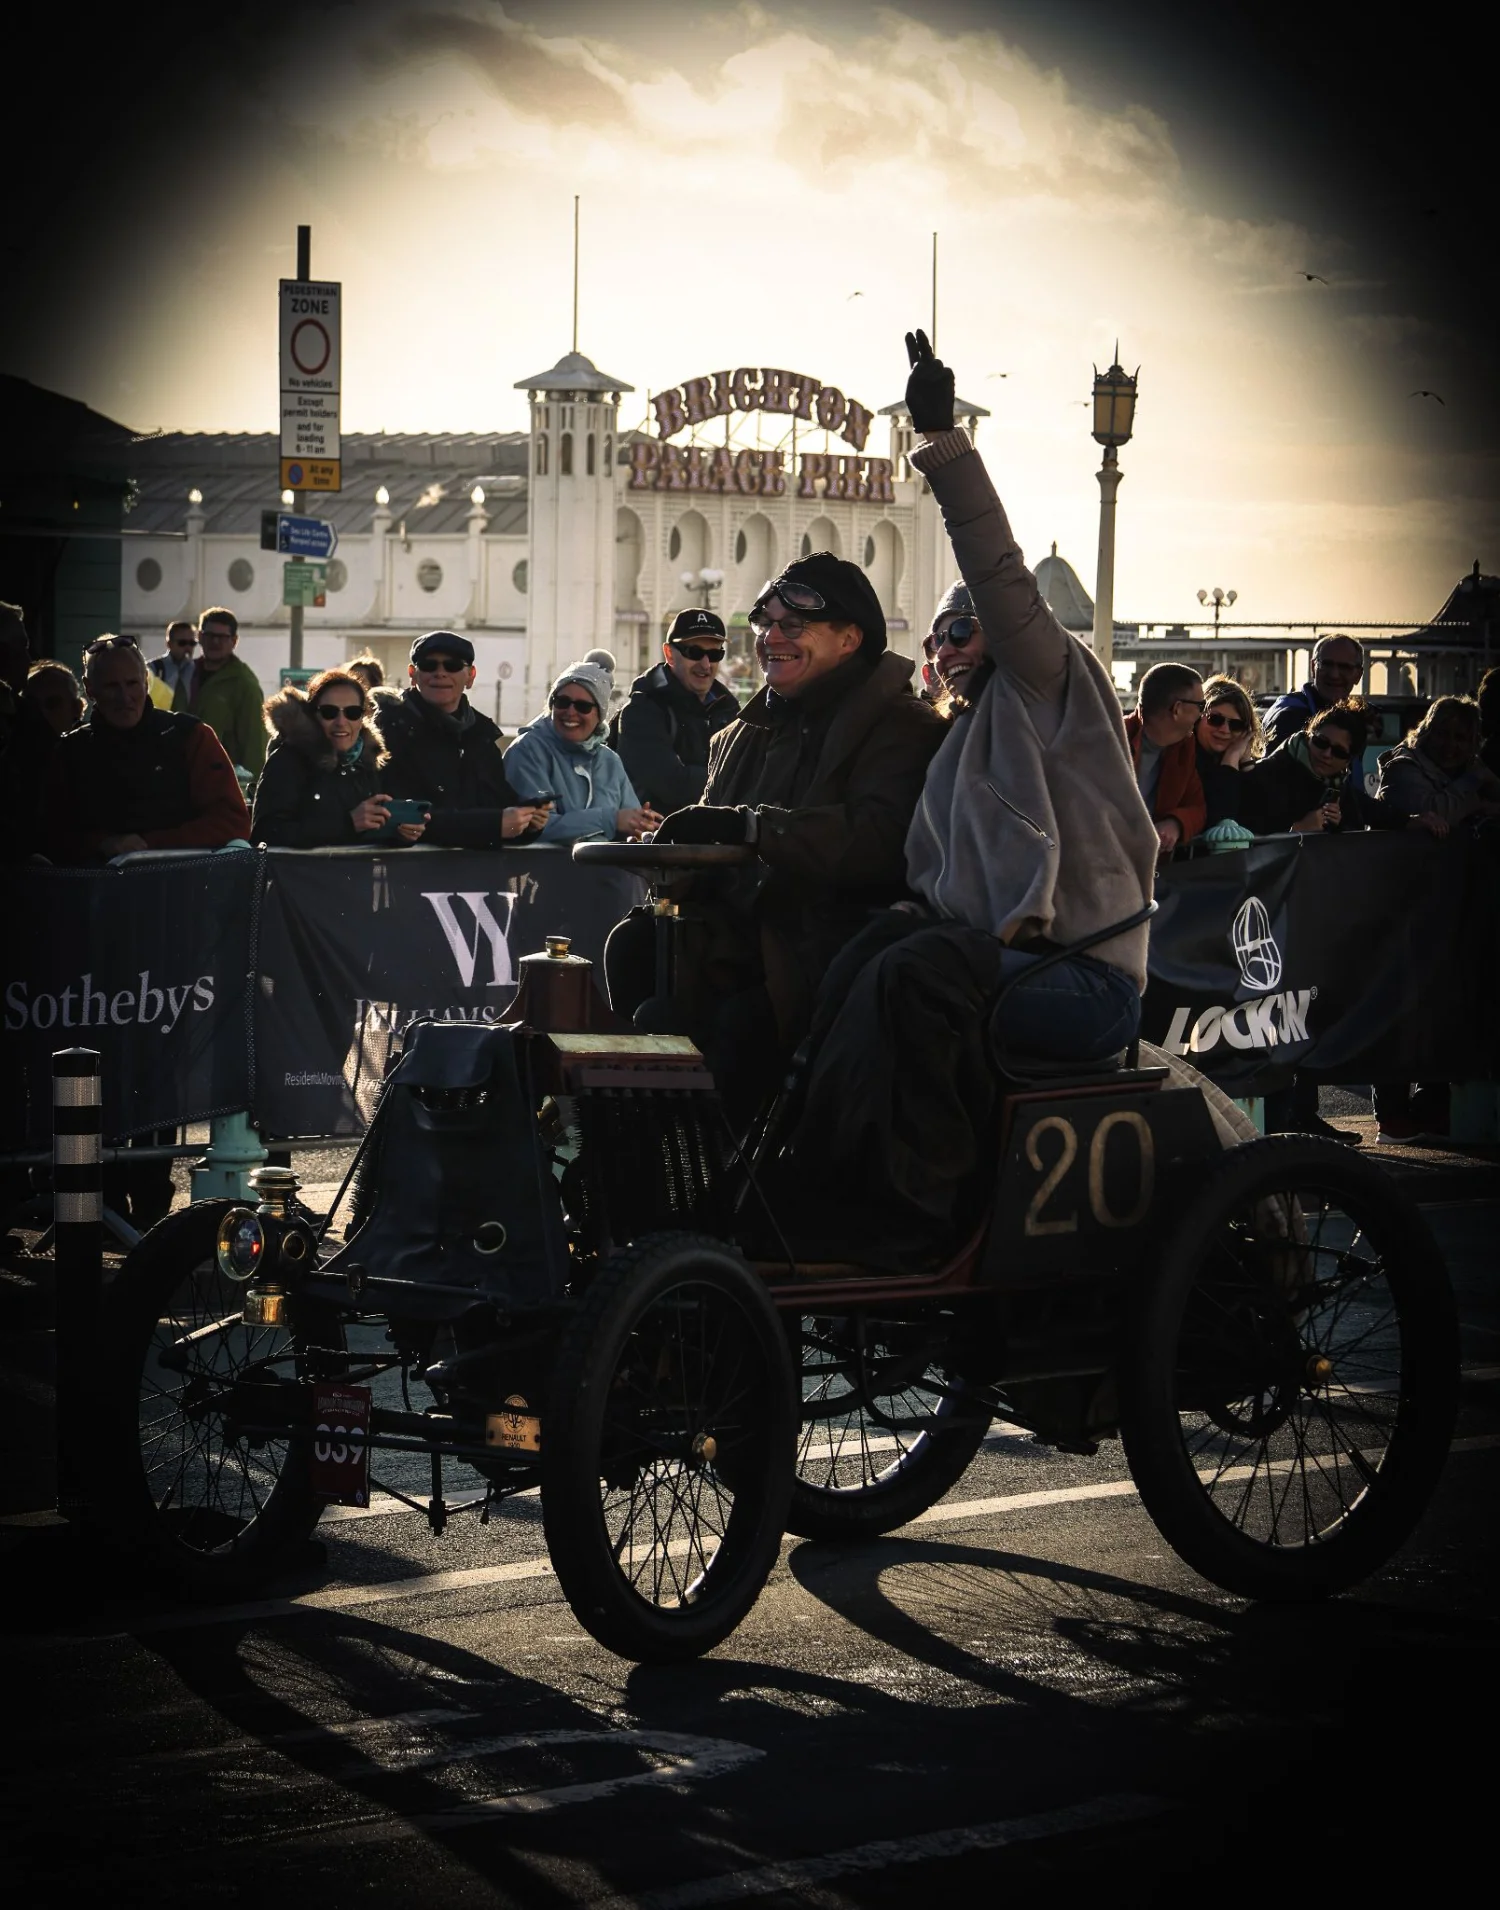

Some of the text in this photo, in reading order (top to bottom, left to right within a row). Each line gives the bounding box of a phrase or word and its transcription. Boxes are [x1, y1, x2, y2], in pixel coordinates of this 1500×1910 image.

[284, 285, 337, 297] PEDESTRIAN
[291, 299, 329, 314] ZONE
[289, 378, 333, 388] No vehicles
[297, 396, 324, 407] Except
[283, 408, 337, 418] permit holders
[650, 368, 874, 451] BRIGHTON
[297, 423, 324, 431] and for
[297, 434, 324, 444] loading
[310, 464, 334, 475] At any
[628, 442, 895, 503] PALACE PIER
[313, 477, 330, 485] time
[697, 613, 708, 623] A
[1024, 1111, 1155, 1237] 20
[501, 1433, 527, 1442] RENAULT
